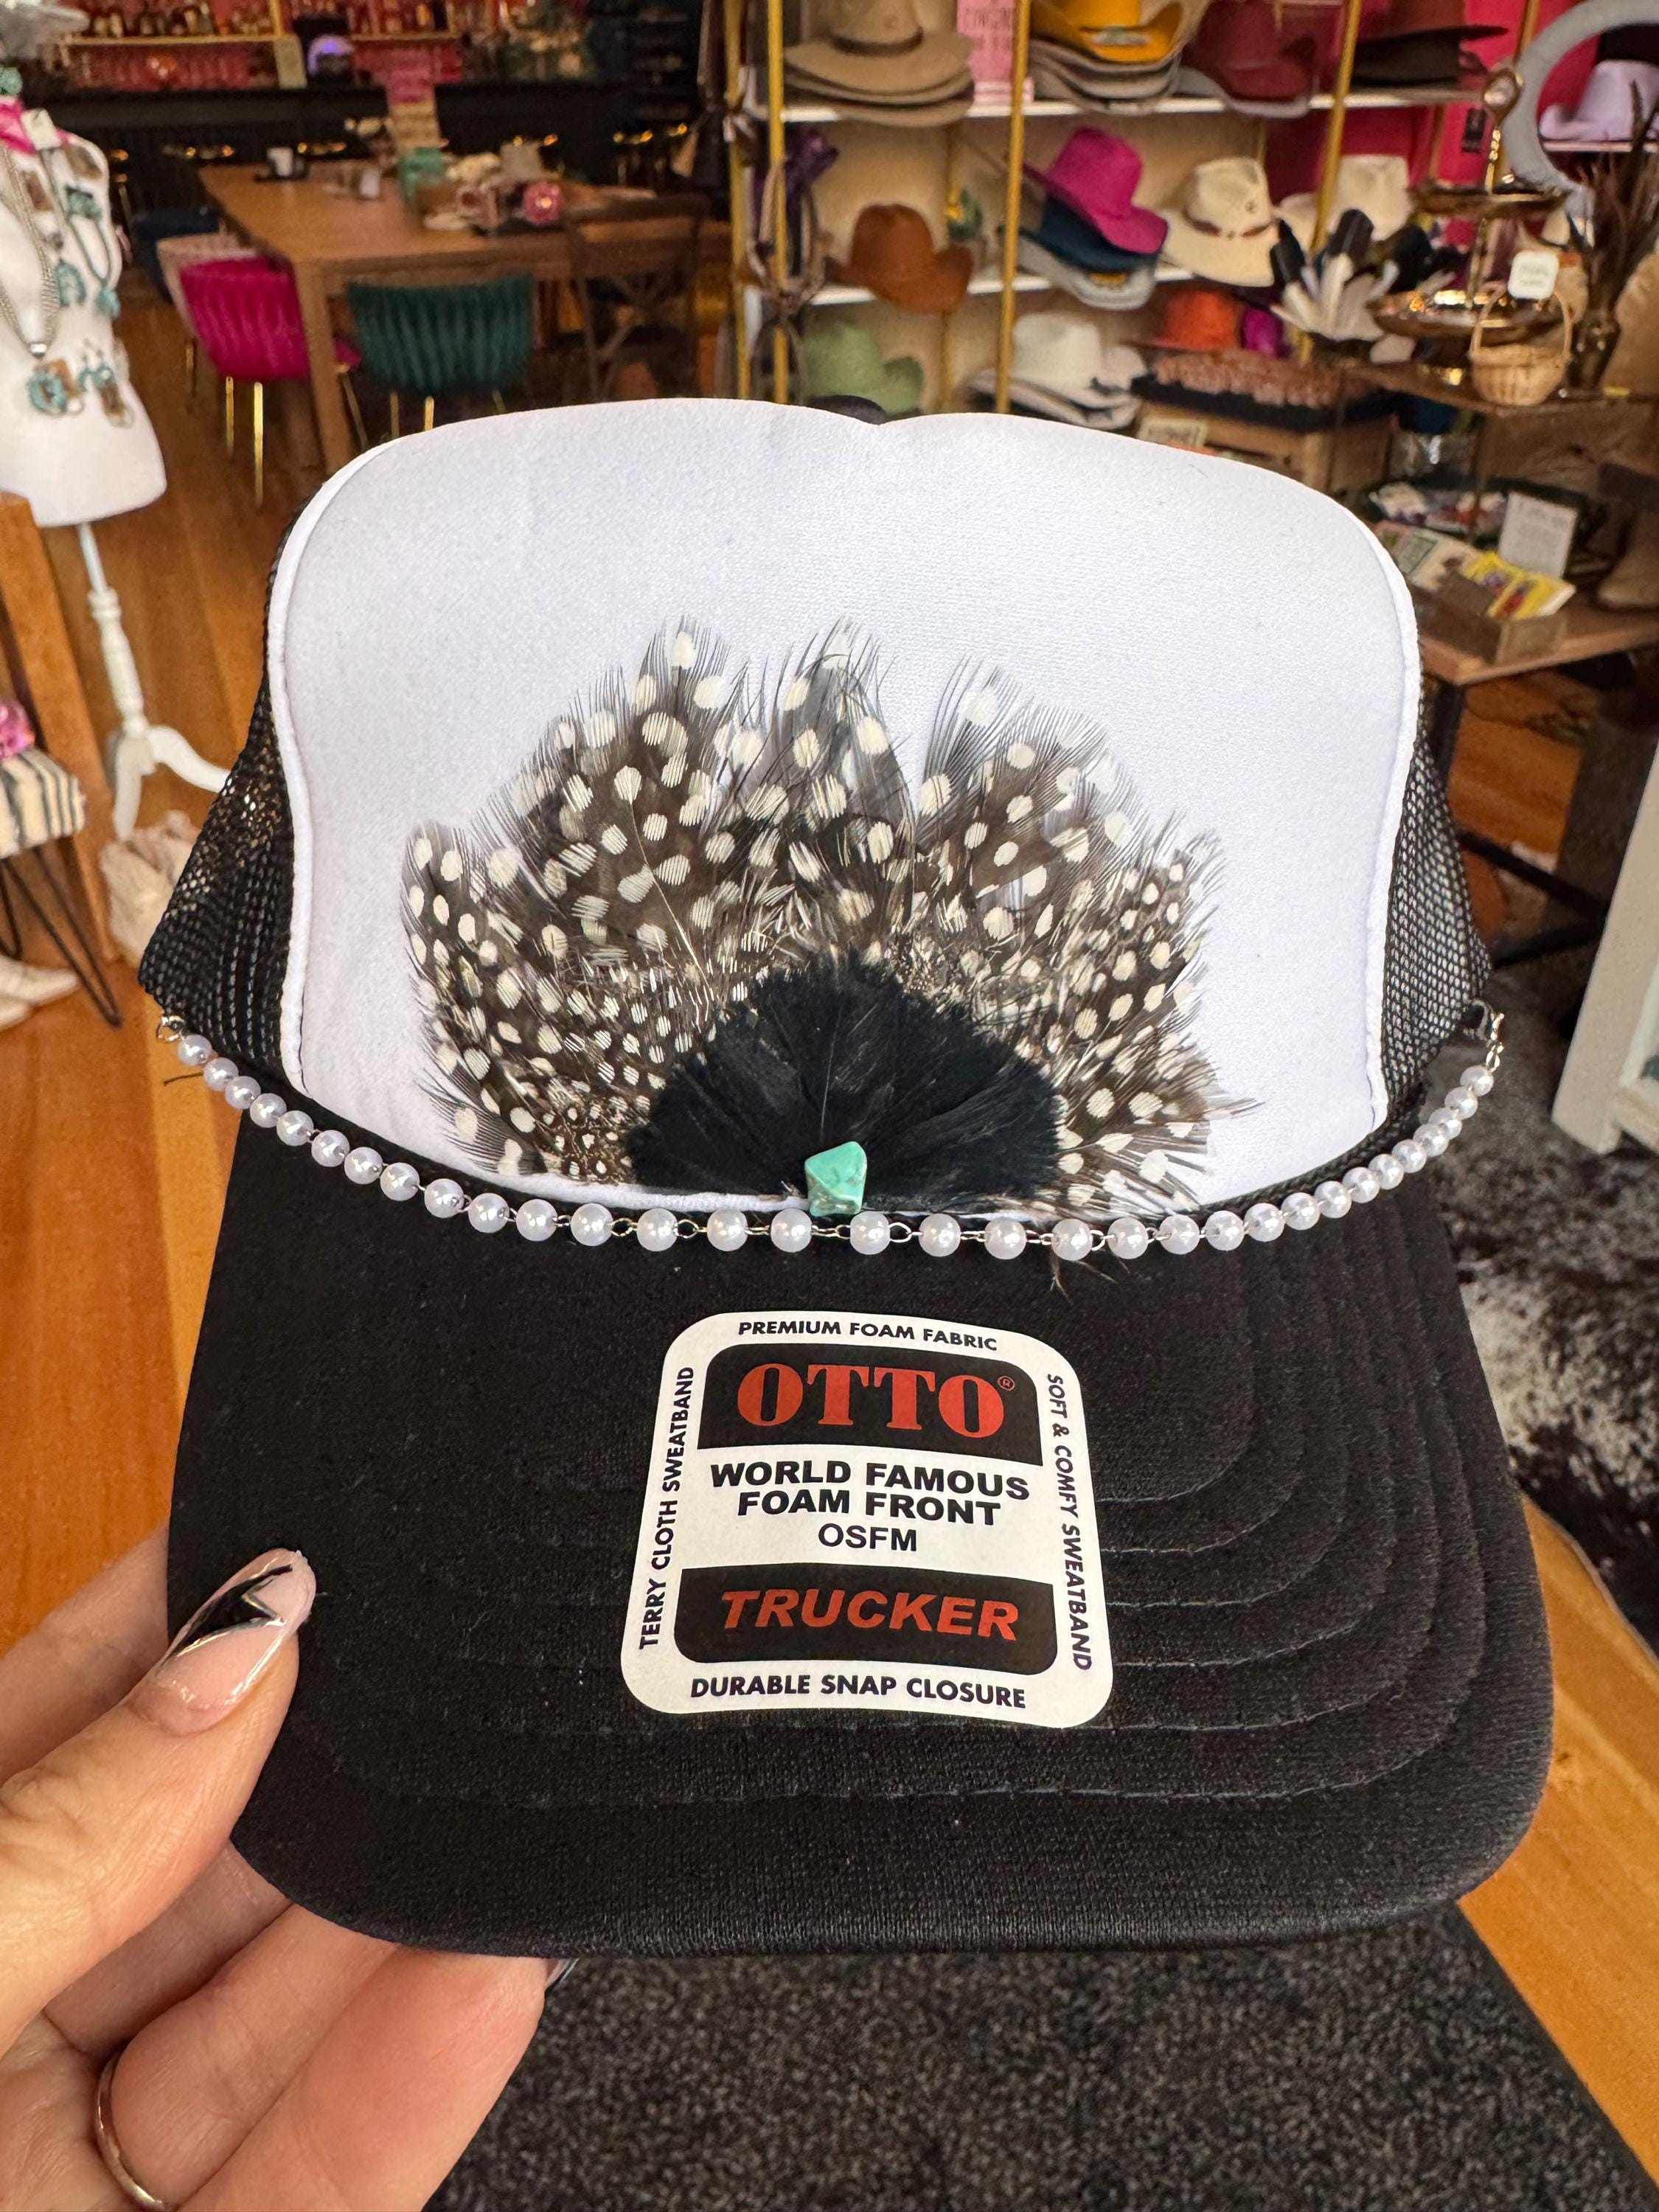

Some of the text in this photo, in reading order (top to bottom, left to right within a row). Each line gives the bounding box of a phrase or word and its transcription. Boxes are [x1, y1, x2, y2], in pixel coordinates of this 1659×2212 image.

[738, 1321, 997, 1351] PREMIUM FOAM FABRIC
[710, 1460, 1030, 1500] WORLD FAMOUS
[639, 1367, 694, 1650] TERRY CLOTH SWEATBAND
[737, 1489, 1001, 1526] FOAM FRONT
[1047, 1374, 1092, 1670] SOFT & COMFY SWEATBAND
[818, 1523, 917, 1552] OSFM
[720, 1588, 1020, 1641] TRUCKER
[690, 1674, 1026, 1709] DURABLE SNAP CLOSURE
